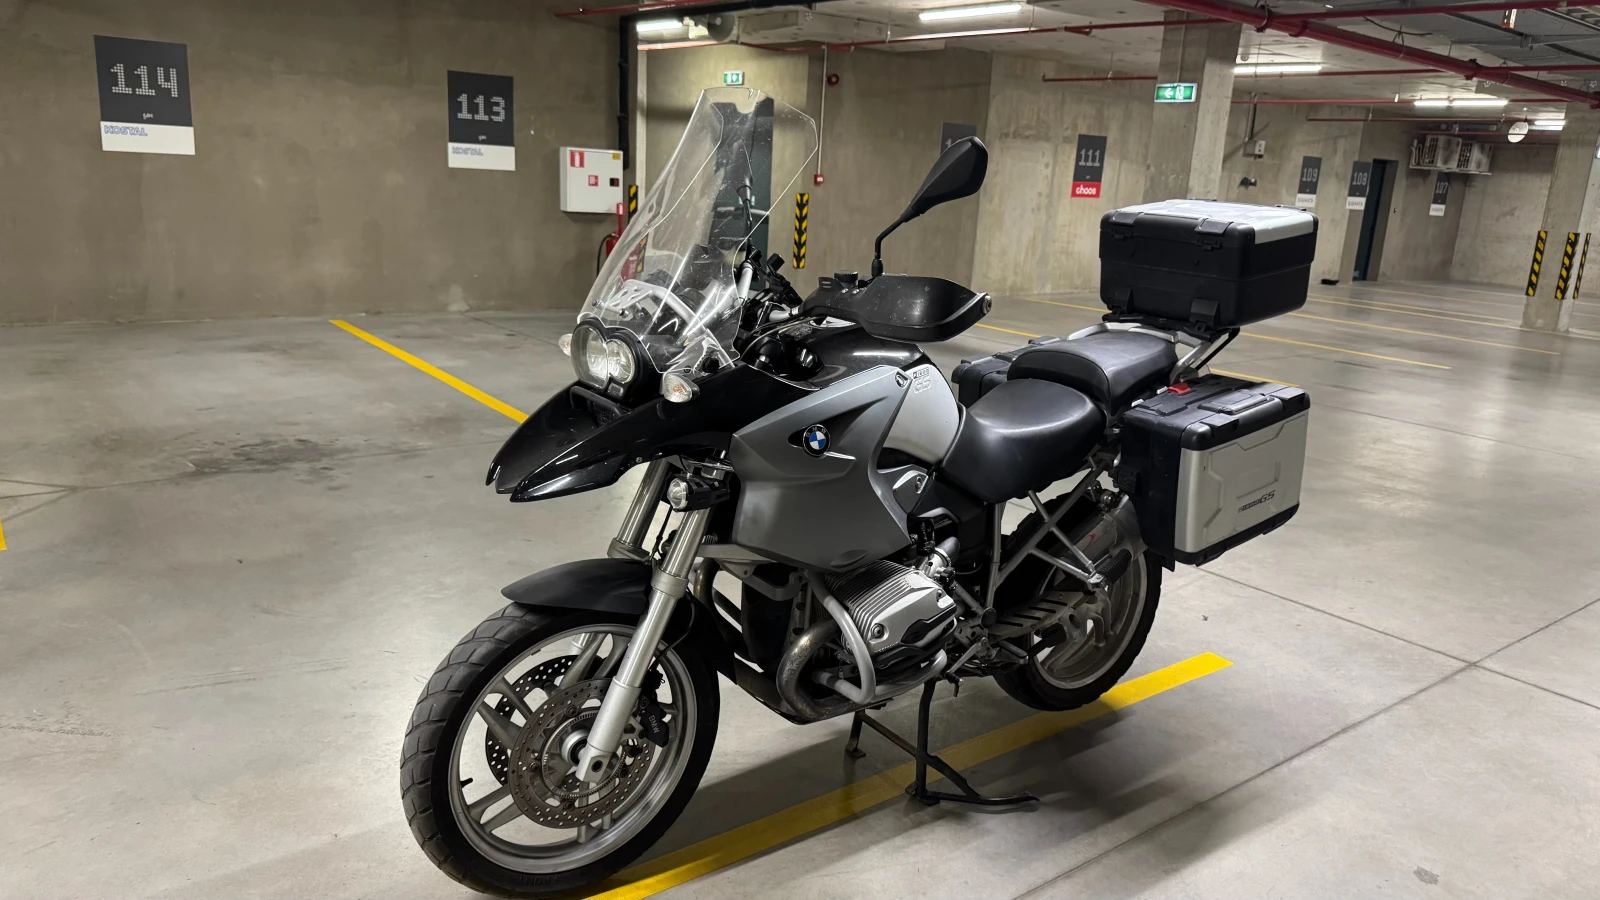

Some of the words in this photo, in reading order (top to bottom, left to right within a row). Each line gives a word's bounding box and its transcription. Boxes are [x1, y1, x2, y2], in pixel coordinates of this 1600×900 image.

[110, 63, 178, 98] 114
[457, 93, 505, 122] 113
[104, 125, 148, 136] KOSTAL
[1079, 148, 1100, 167] 111
[1302, 167, 1318, 182] 109
[1352, 172, 1368, 186] 108
[1075, 184, 1097, 195] chaos
[648, 714, 660, 734] BMW
